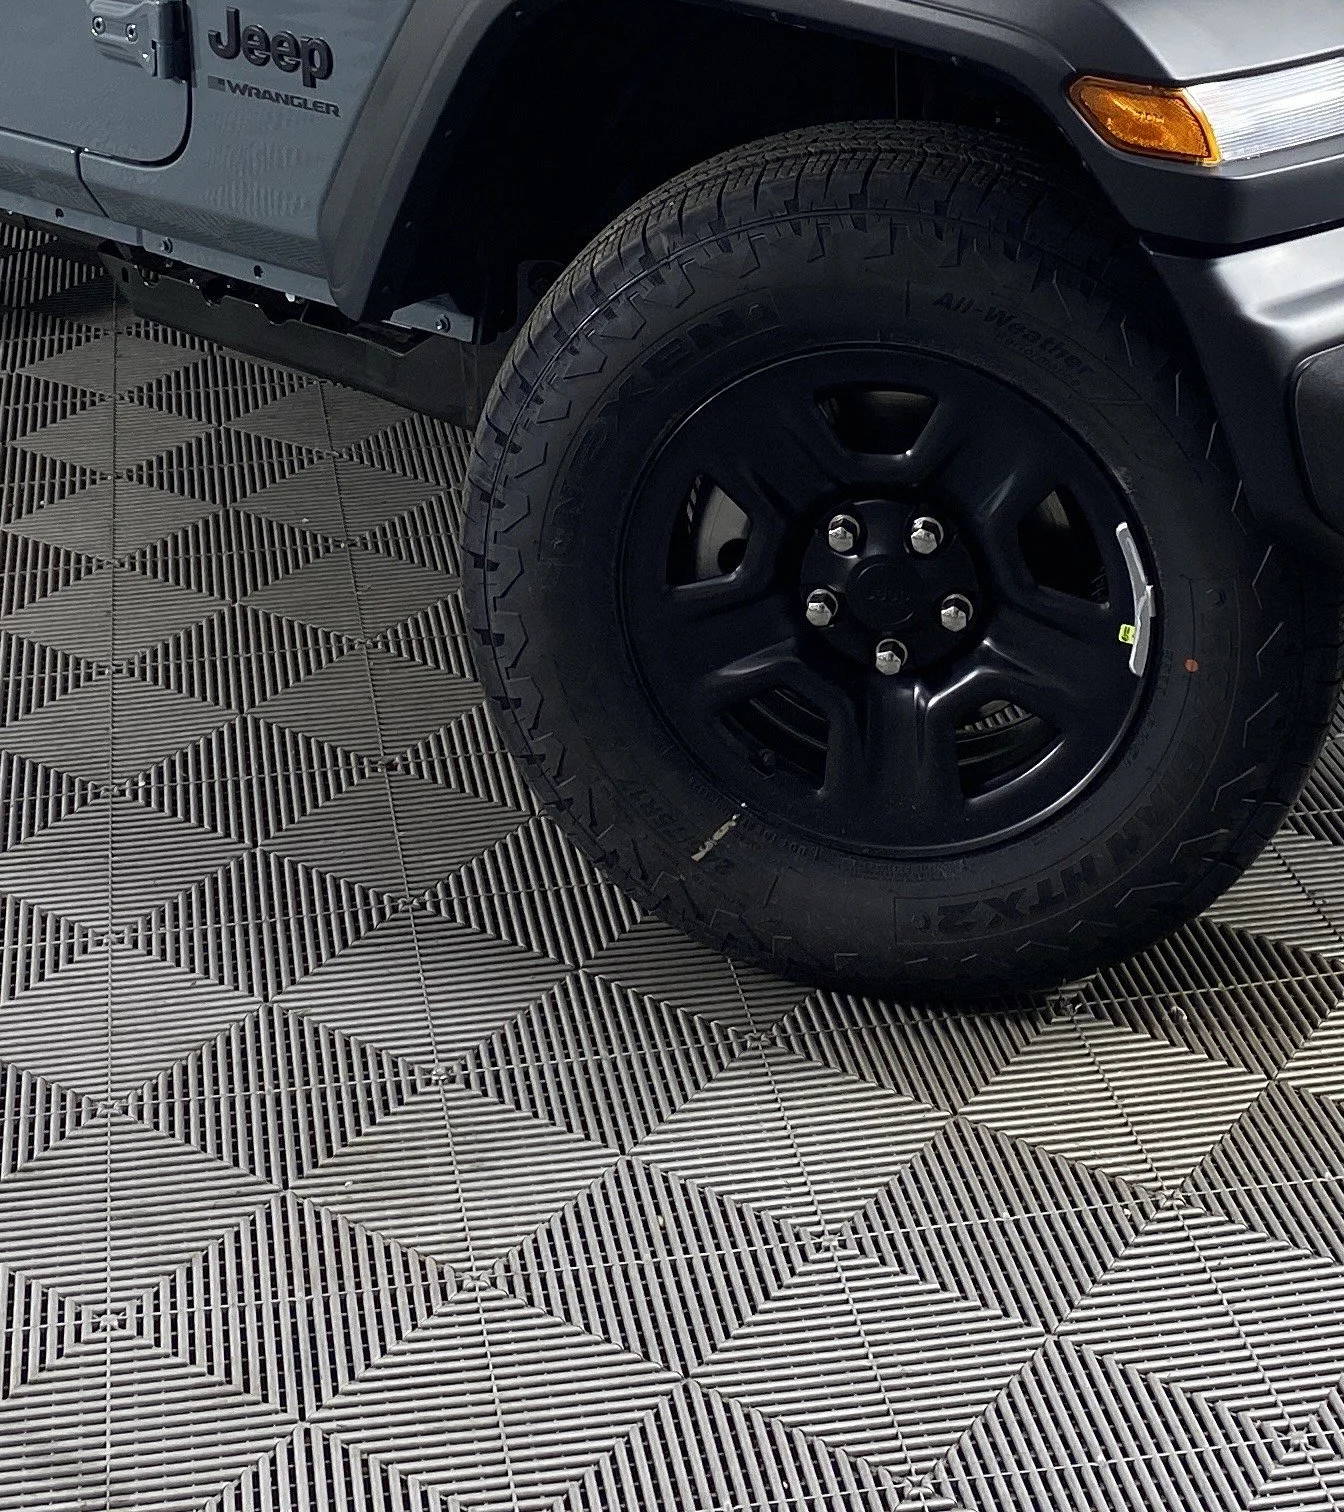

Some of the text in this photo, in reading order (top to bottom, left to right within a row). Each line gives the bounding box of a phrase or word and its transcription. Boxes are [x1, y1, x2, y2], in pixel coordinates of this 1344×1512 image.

[208, 6, 334, 88] Jeep
[226, 79, 341, 118] WRANGLER
[932, 291, 1097, 375] All-Weather
